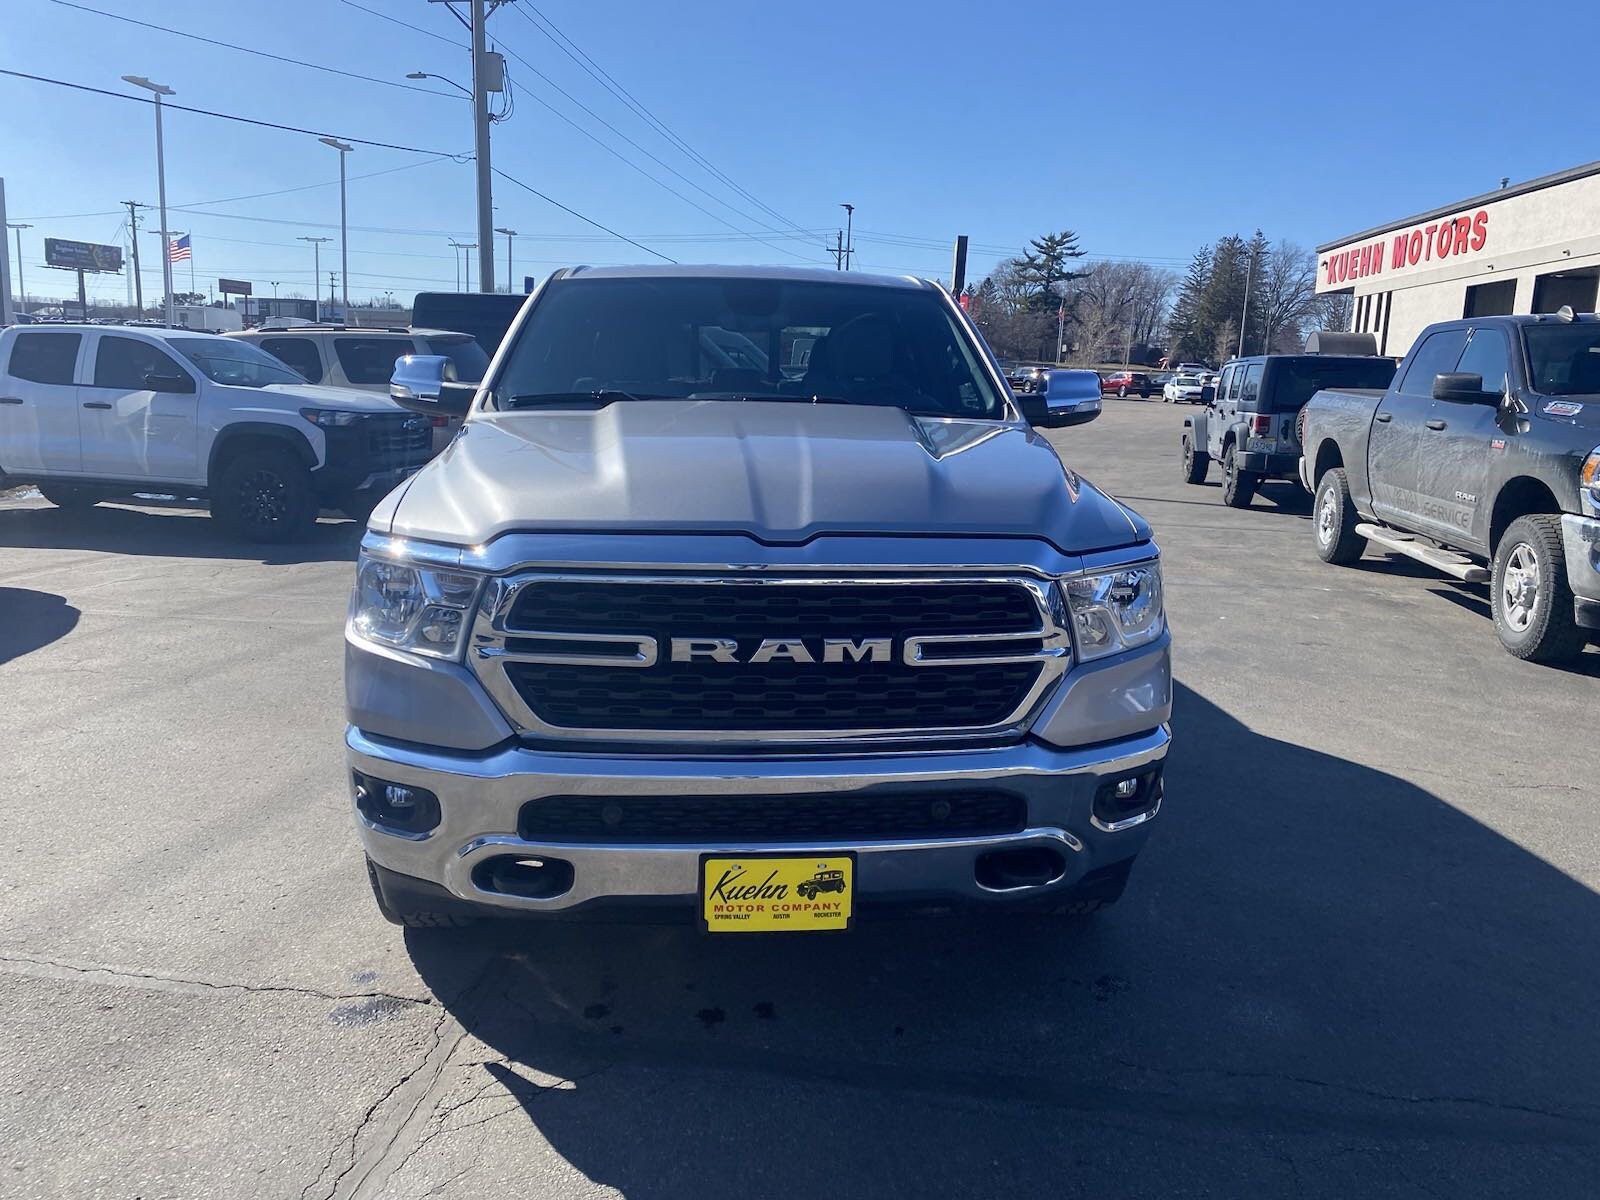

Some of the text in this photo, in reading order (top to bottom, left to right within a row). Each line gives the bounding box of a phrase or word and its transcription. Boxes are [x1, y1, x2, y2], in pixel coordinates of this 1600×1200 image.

[1327, 210, 1489, 285] KUEHN MOTORS
[1455, 490, 1477, 503] RAM
[671, 637, 893, 663] RAM
[709, 869, 789, 904] Kuehn
[713, 902, 841, 913] MOTOR COMPANY
[813, 911, 842, 919] ROCHESTER
